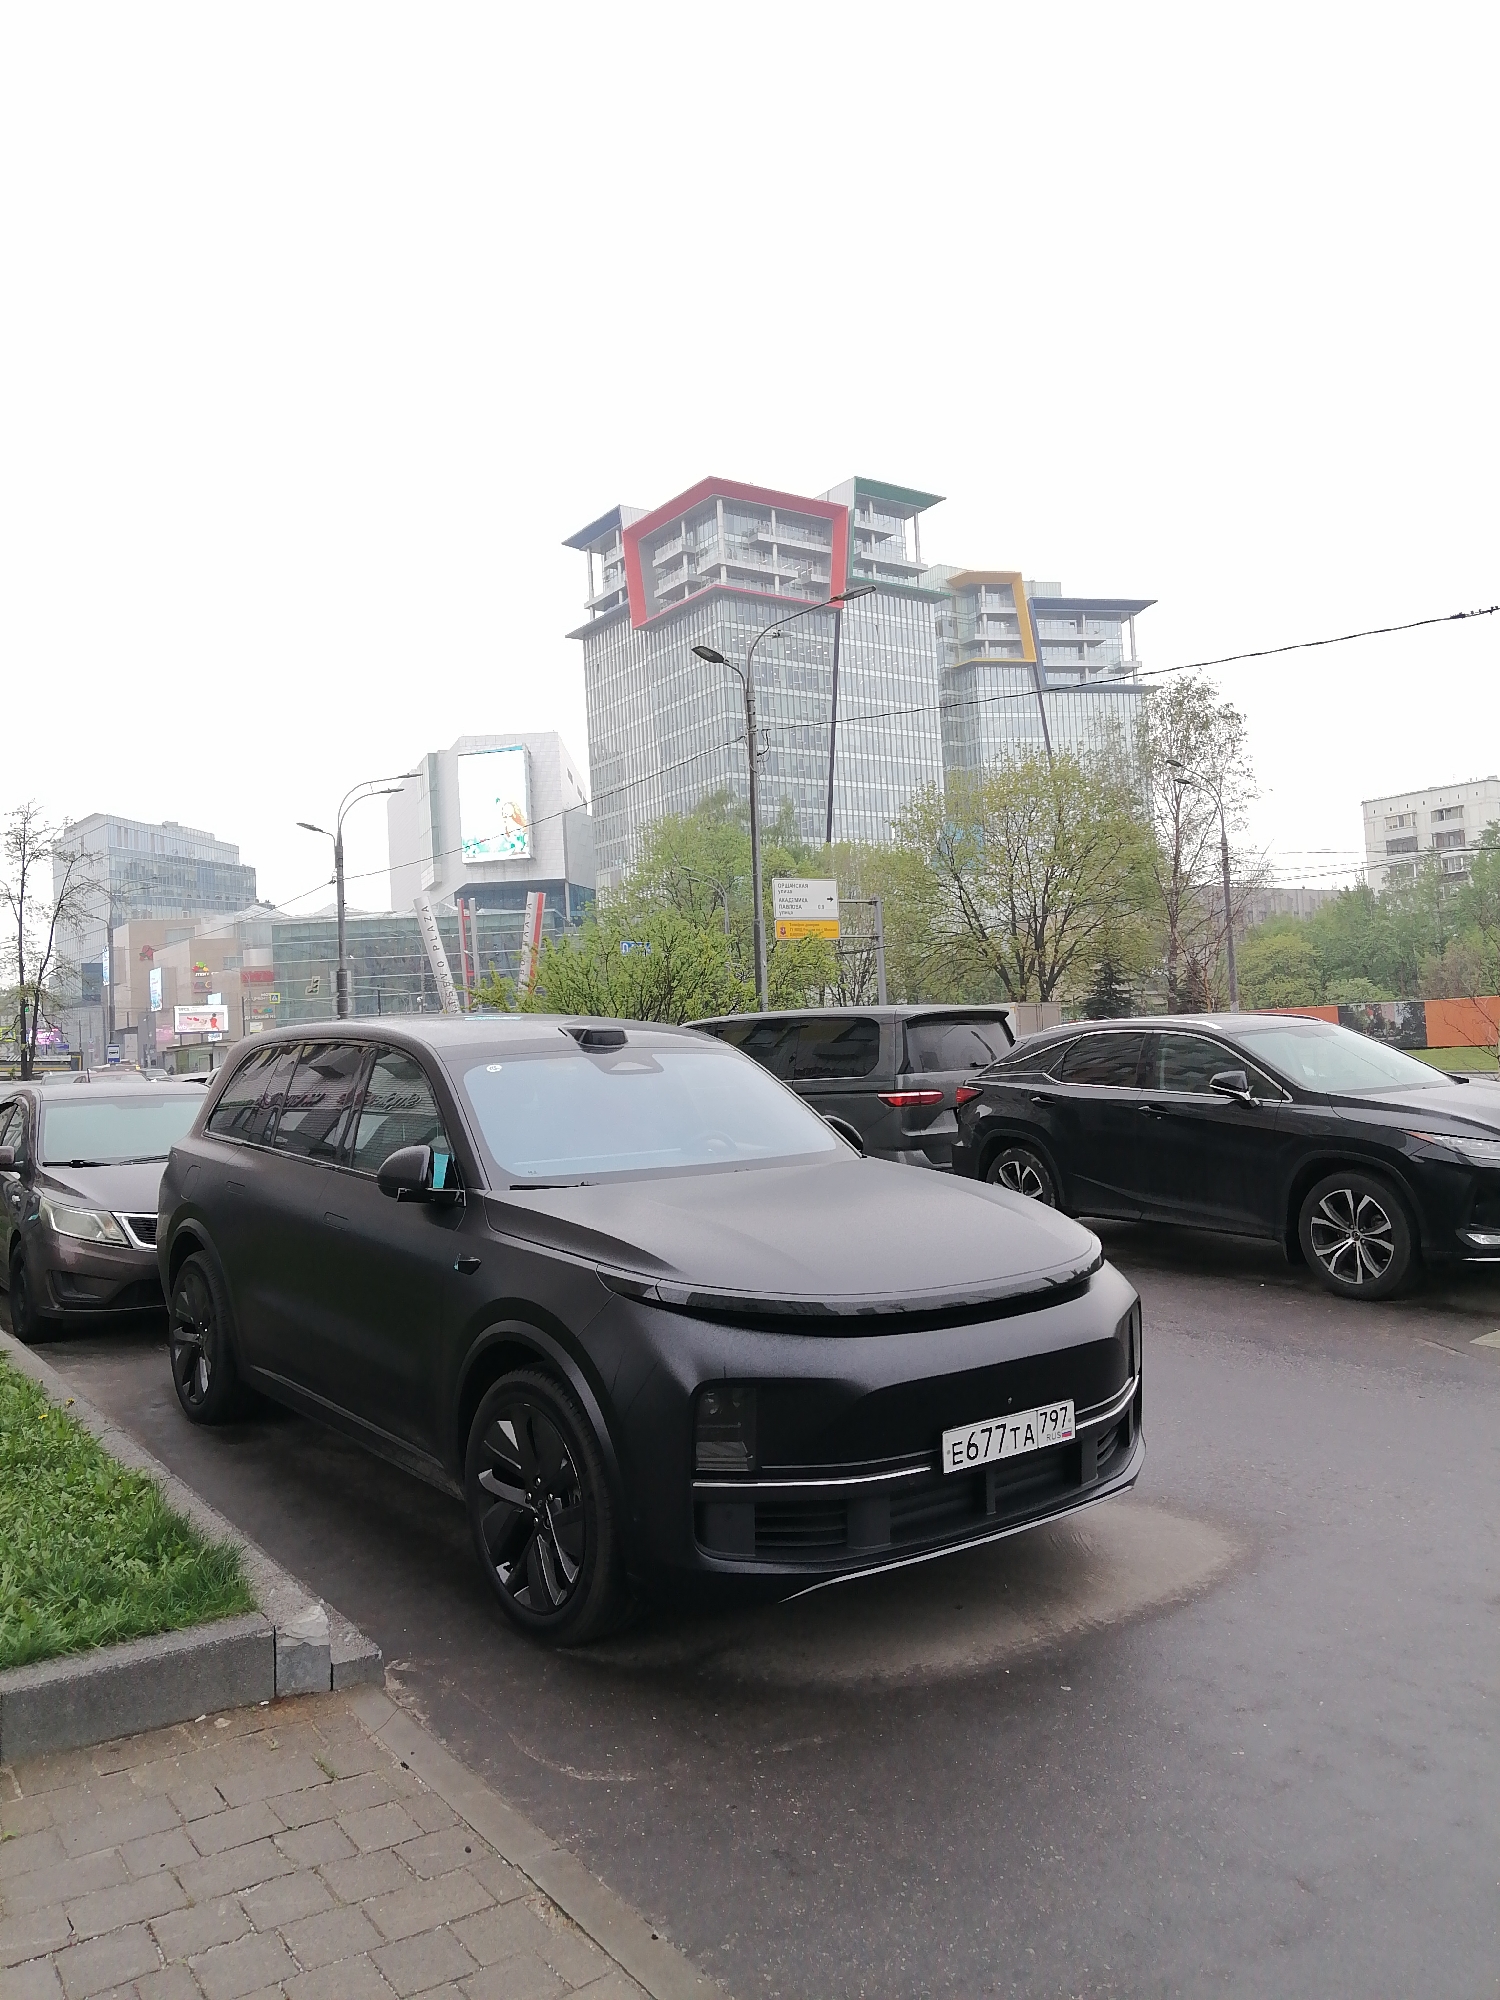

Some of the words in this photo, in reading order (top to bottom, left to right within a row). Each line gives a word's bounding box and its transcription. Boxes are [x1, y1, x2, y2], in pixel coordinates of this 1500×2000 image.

[421, 904, 441, 953] PLAZA
[952, 1423, 1034, 1465] Е677ТА
[1040, 1406, 1067, 1434] 797
[1046, 1431, 1062, 1442] RUS
